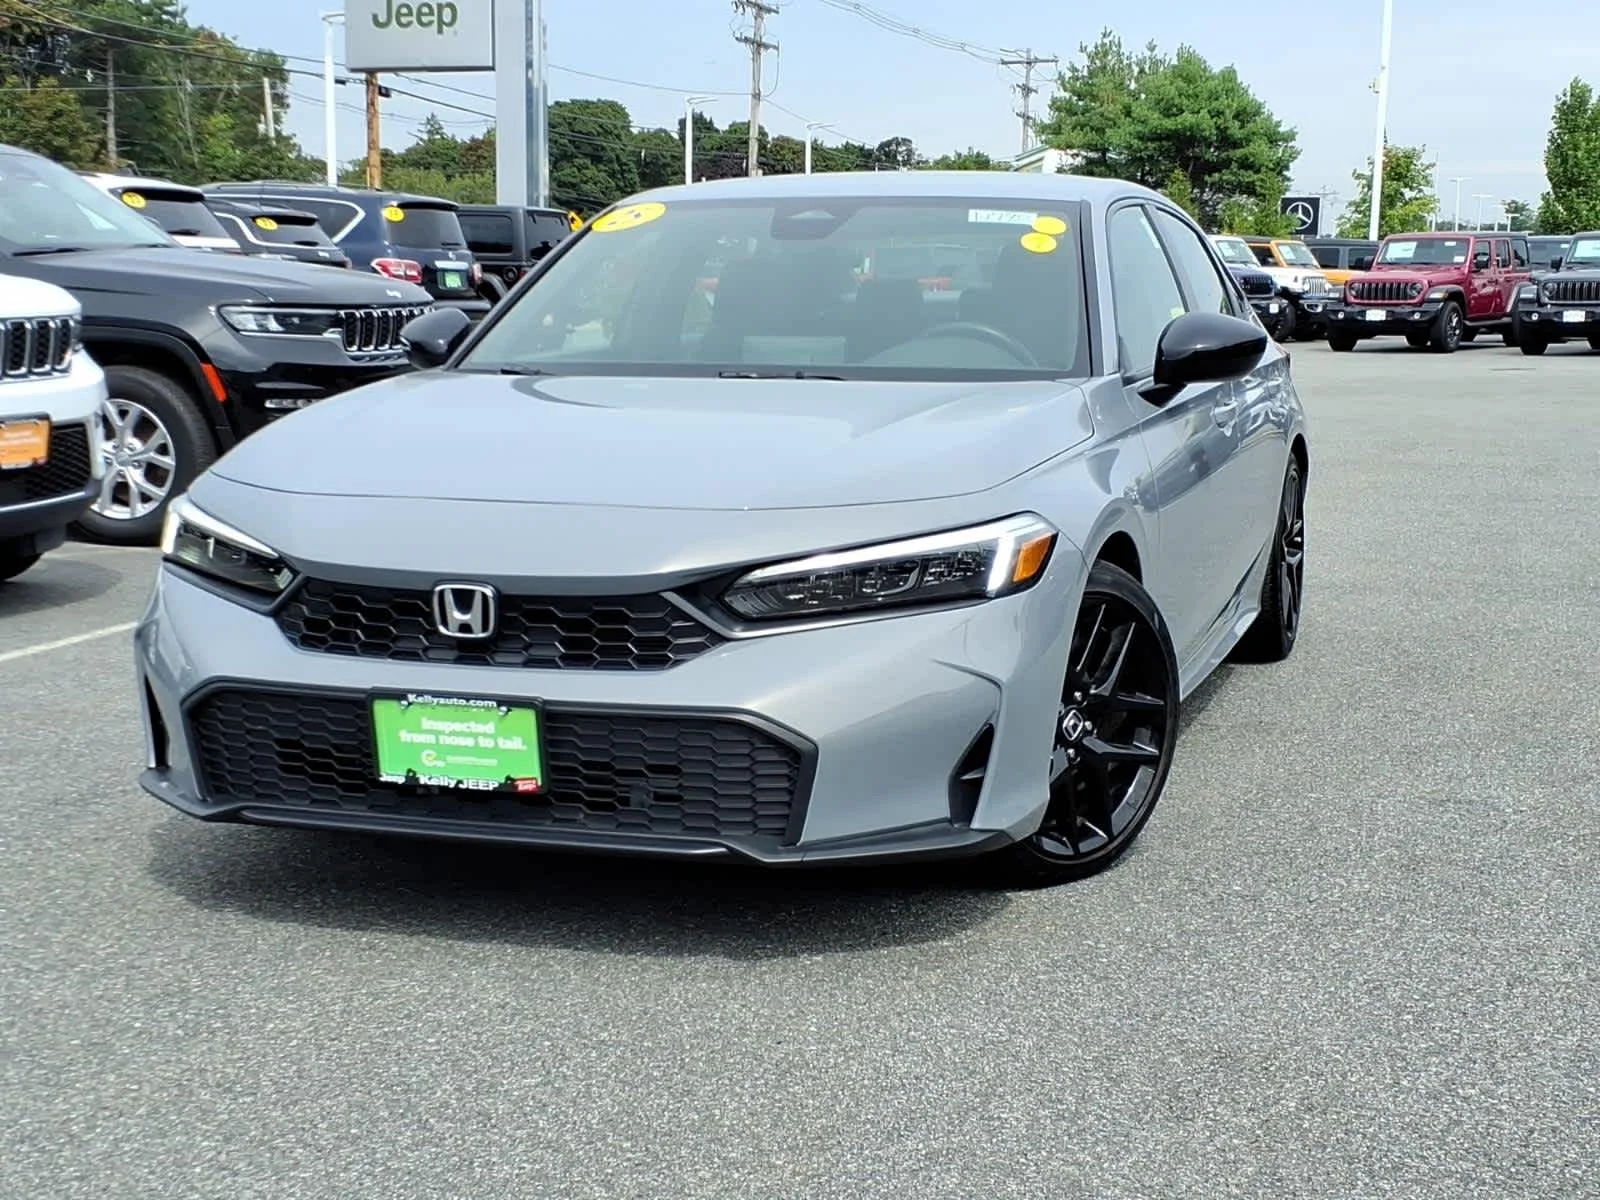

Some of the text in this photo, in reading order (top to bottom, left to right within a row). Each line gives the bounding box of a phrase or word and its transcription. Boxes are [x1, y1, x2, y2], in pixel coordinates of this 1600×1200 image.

[372, 0, 458, 34] Jeep
[407, 693, 497, 708] Kellyauto.com
[421, 717, 496, 735] Inspected
[399, 729, 527, 750] from nose to tail.
[419, 775, 457, 788] Kelly
[459, 779, 499, 791] JEEP
